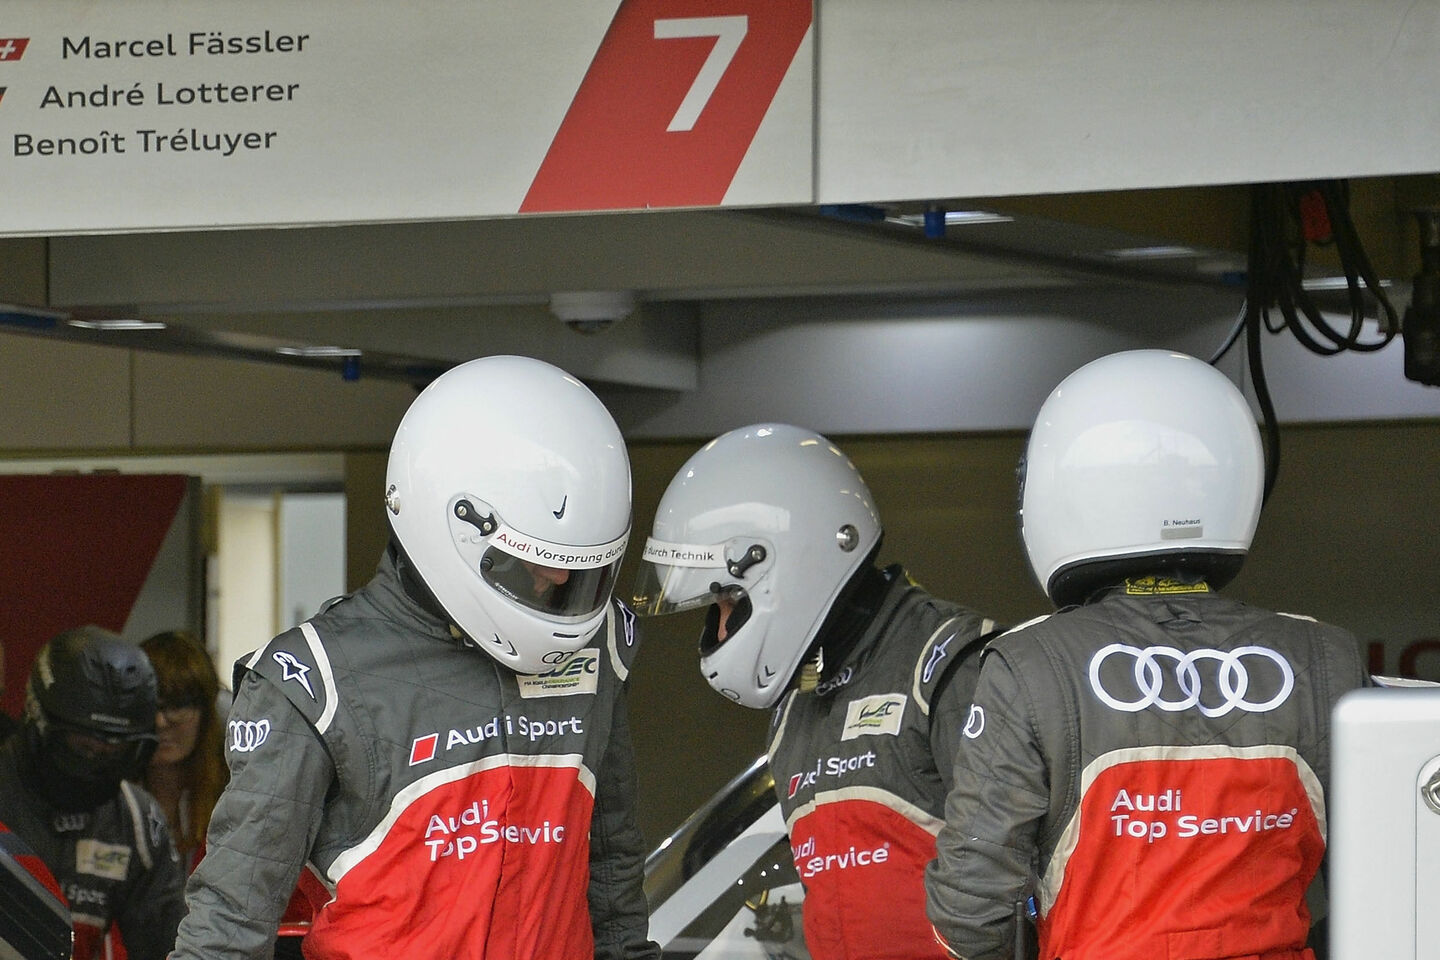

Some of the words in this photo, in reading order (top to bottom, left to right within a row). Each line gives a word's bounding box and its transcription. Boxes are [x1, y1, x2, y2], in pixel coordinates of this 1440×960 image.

[62, 33, 177, 60] Marcel
[188, 30, 309, 56] Fässler
[654, 15, 748, 132] 7
[39, 82, 145, 109] André
[157, 82, 300, 105] Lotterer
[14, 130, 126, 157] Benoît
[136, 128, 277, 156] Tréluyer
[496, 532, 532, 553] Audi
[535, 546, 603, 564] Vorsprung
[671, 549, 714, 560] Technik
[446, 717, 513, 750] Audi
[519, 715, 583, 741] Sport
[826, 751, 876, 777] Sport
[1111, 788, 1182, 811] Audi
[425, 800, 488, 837] Audi
[1111, 815, 1166, 842] Top
[1177, 810, 1294, 838] Service
[425, 836, 477, 861] Top
[791, 836, 815, 861] udi
[803, 847, 889, 878] Service
